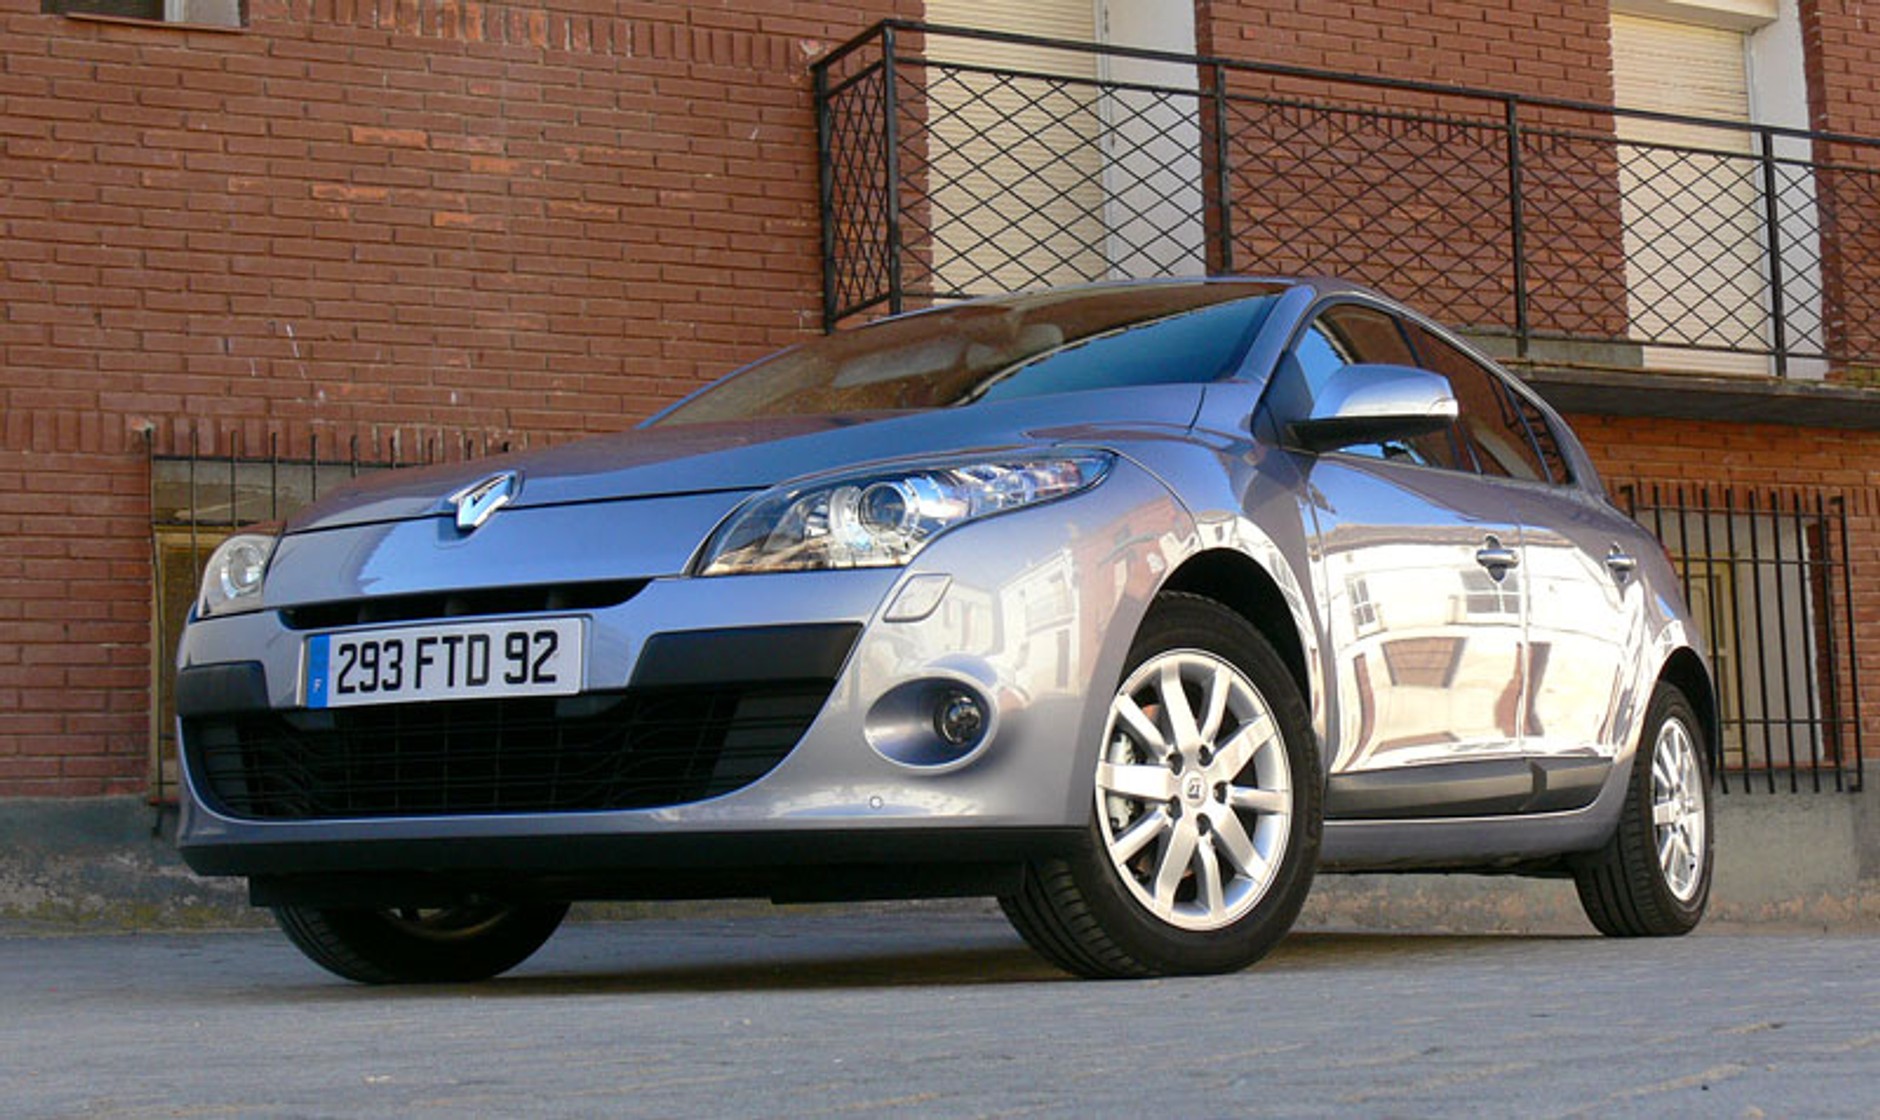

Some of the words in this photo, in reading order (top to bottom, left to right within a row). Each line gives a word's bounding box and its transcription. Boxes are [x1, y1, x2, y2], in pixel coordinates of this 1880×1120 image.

[337, 639, 403, 694] 293
[414, 634, 490, 689] FTD
[504, 630, 558, 684] 92
